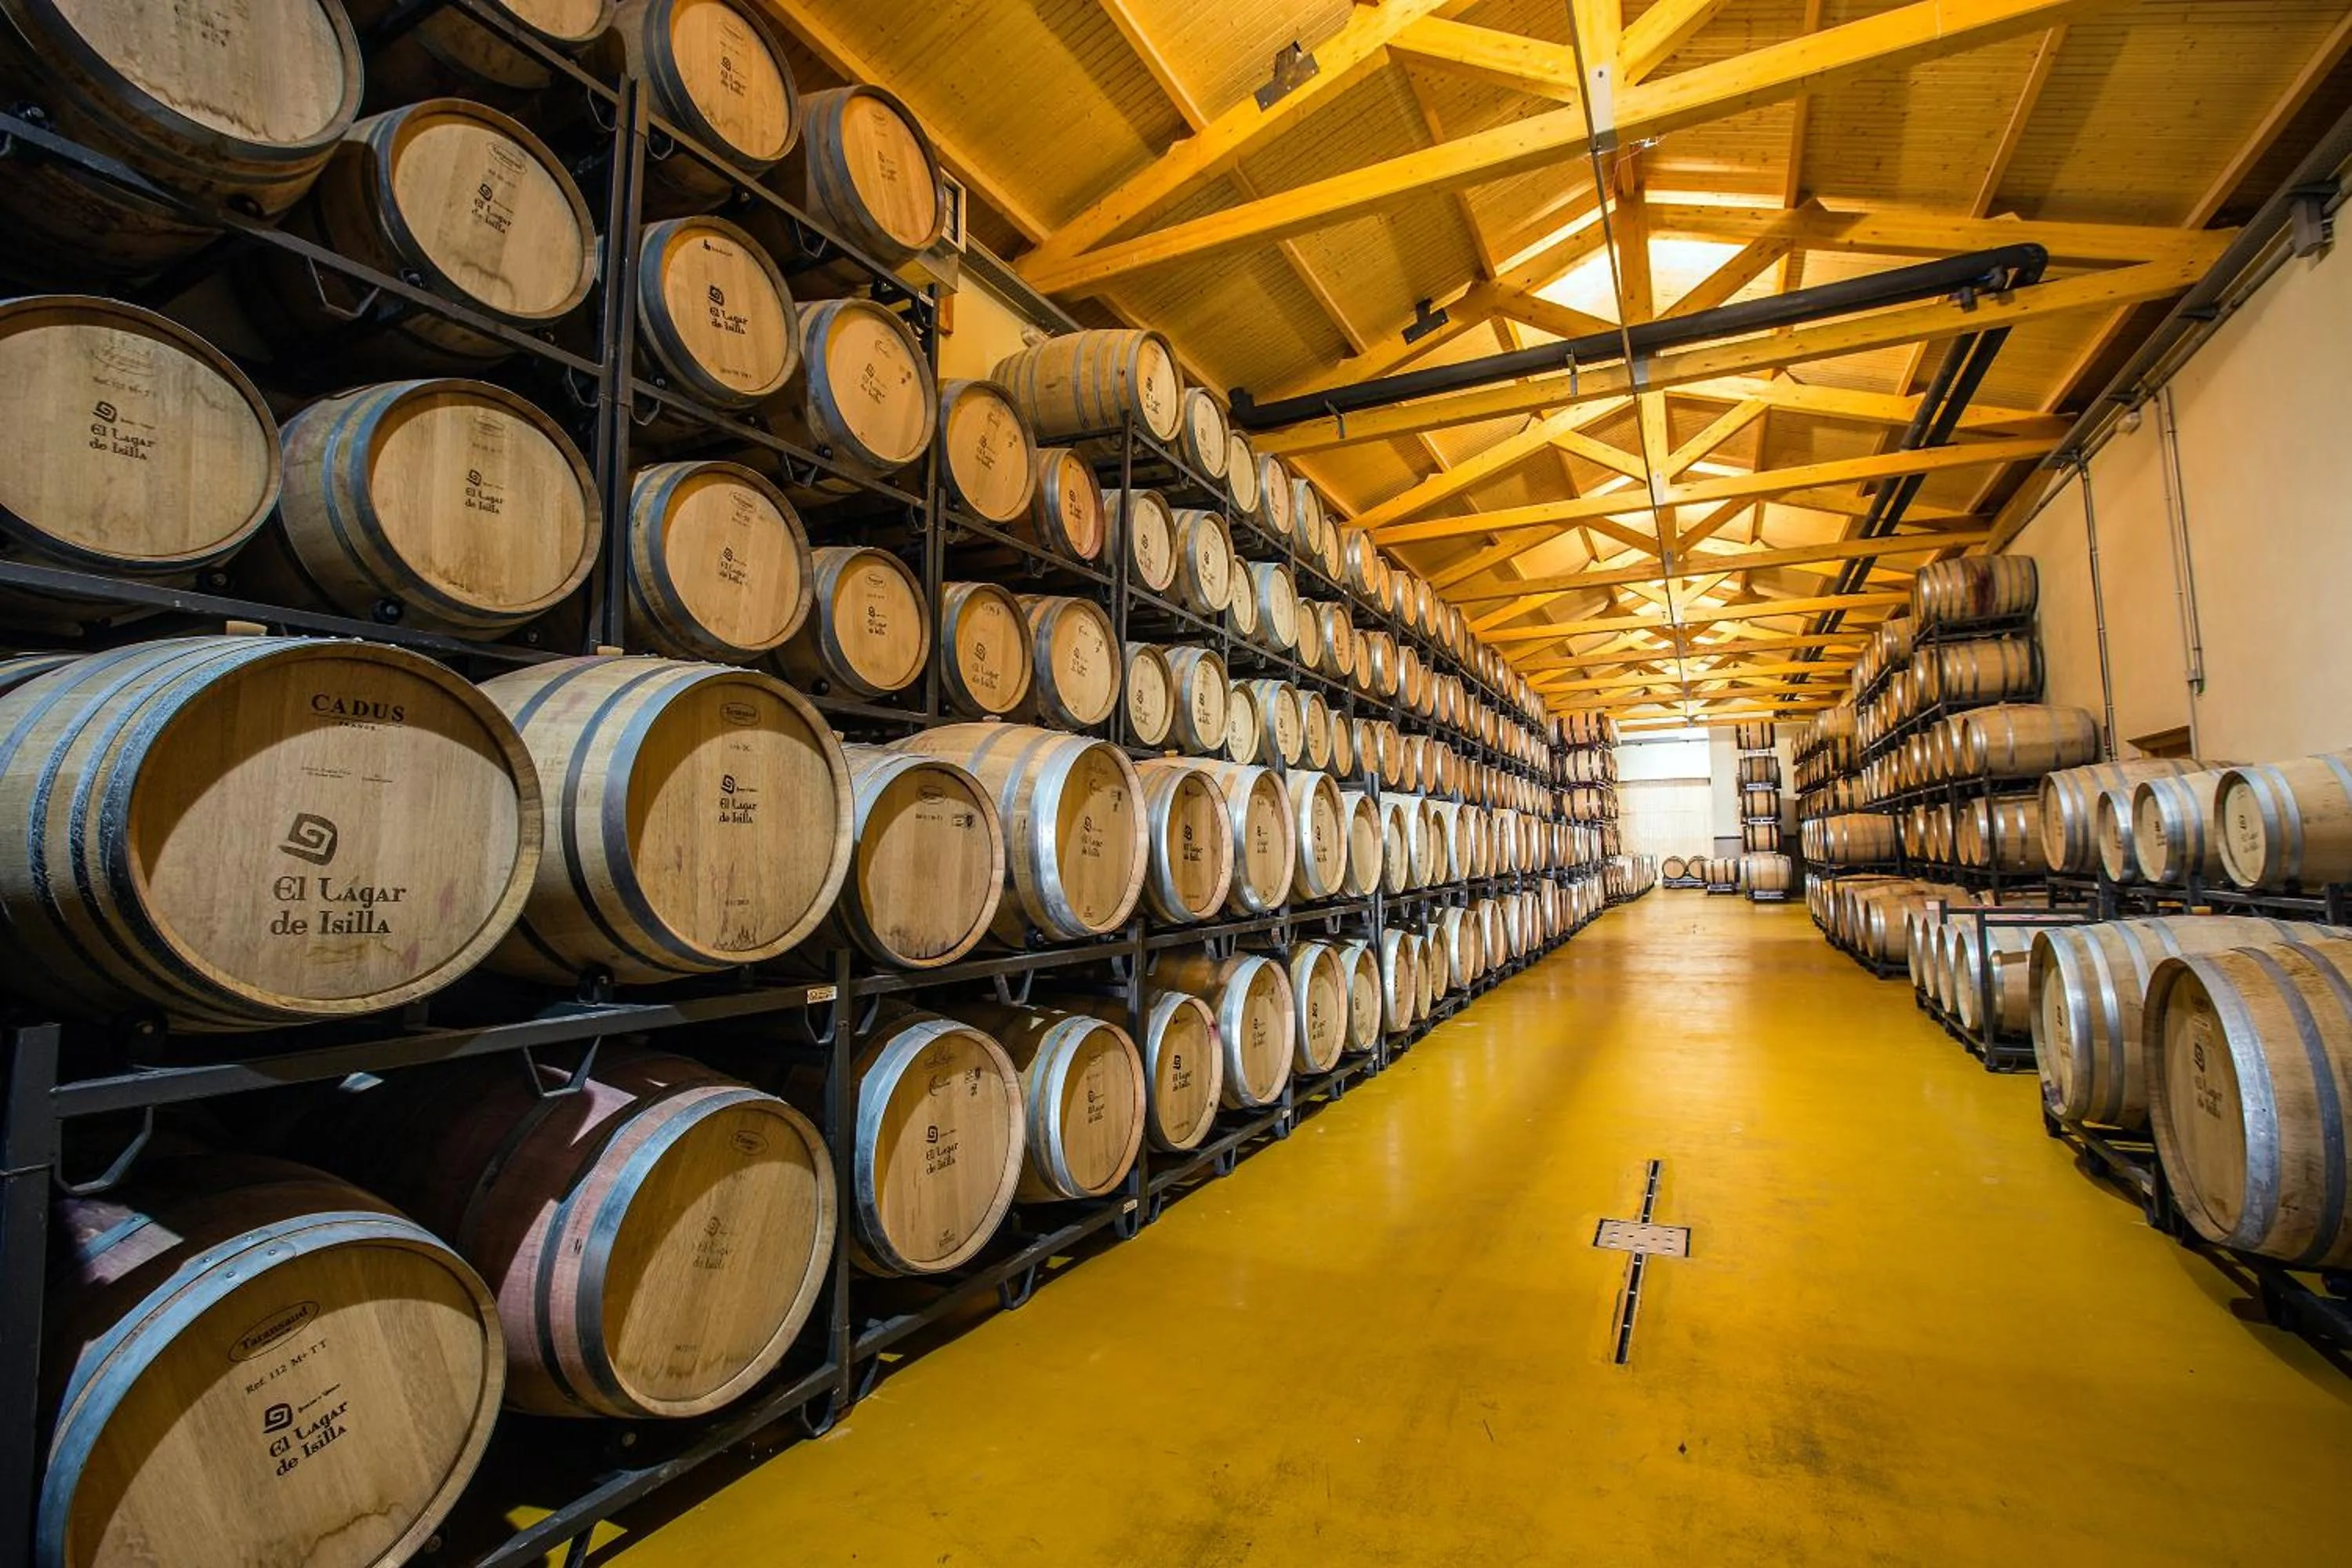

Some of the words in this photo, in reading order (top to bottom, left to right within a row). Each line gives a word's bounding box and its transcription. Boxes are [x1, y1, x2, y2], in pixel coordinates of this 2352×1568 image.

[311, 694, 405, 723] CADUS
[274, 876, 307, 902] El
[270, 909, 308, 935] de
[241, 1305, 309, 1350] Taransaud
[270, 1436, 291, 1457] El
[276, 1457, 299, 1476] de
